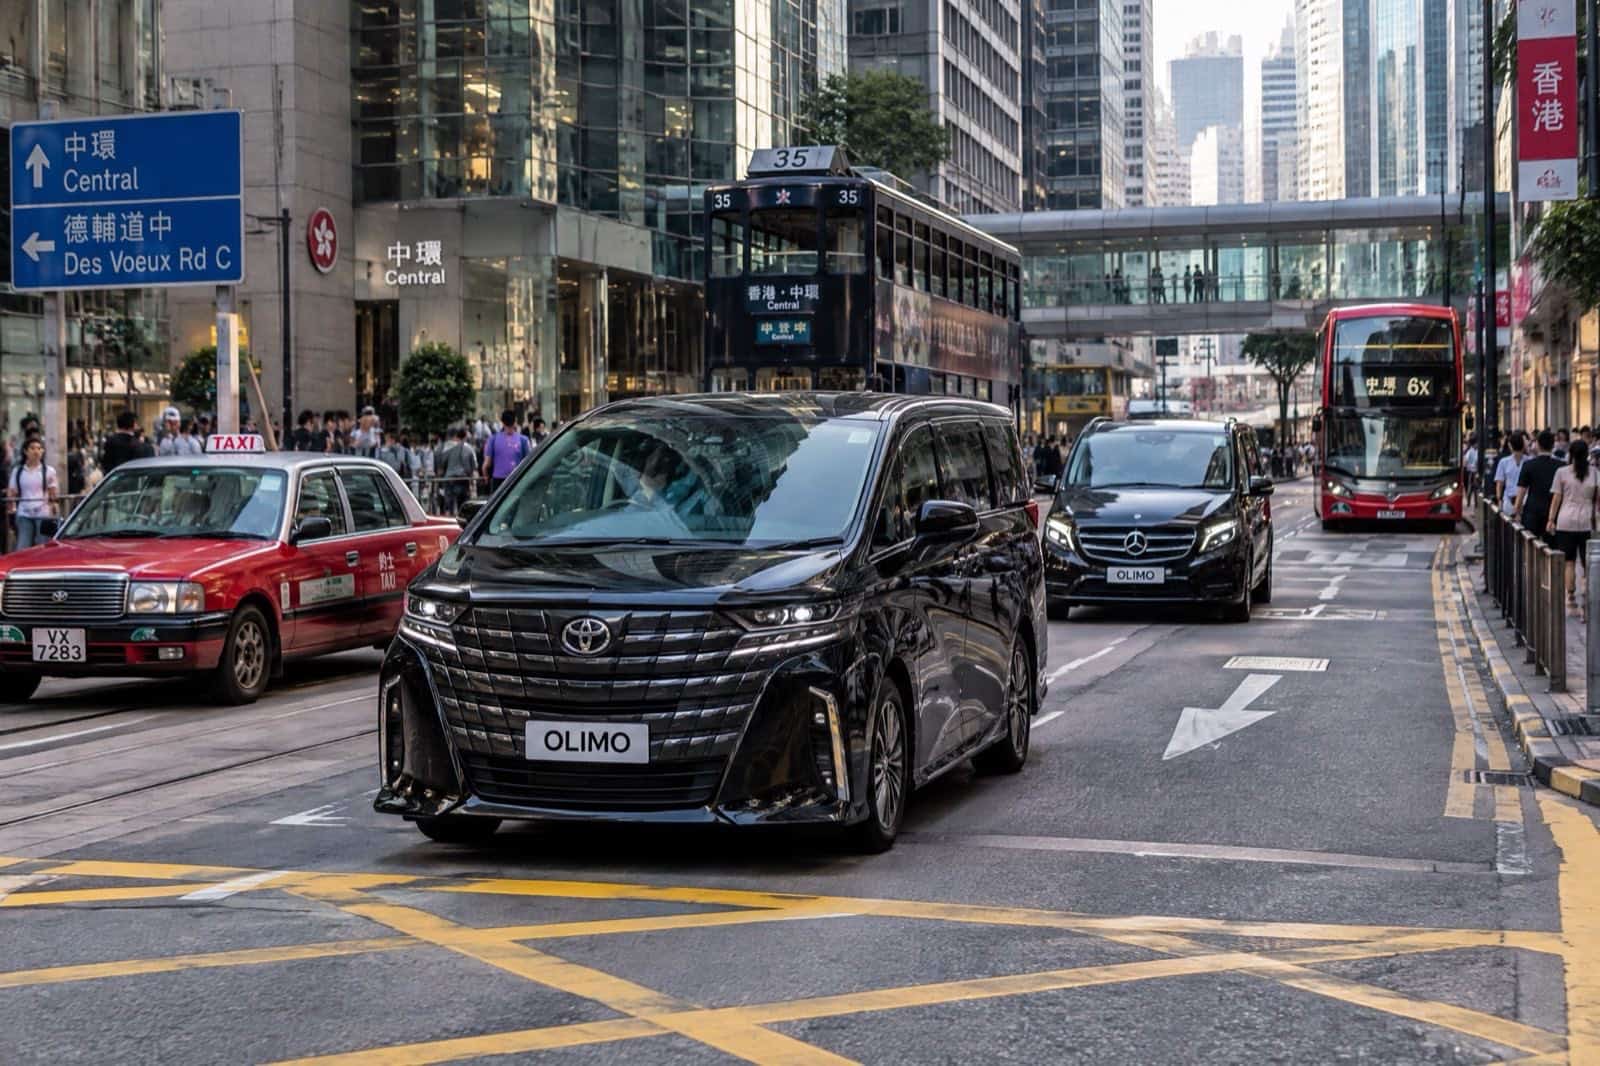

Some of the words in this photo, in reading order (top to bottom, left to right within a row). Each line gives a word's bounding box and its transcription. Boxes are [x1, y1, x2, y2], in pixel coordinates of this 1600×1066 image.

[1532, 60, 1564, 132] 香港
[64, 130, 116, 162] 中環
[774, 149, 809, 168] 35
[63, 167, 139, 193] Central
[715, 193, 731, 208] 35
[839, 190, 858, 204] 35
[64, 210, 172, 244] 德輔道中
[64, 252, 103, 275] Des
[110, 250, 171, 274] Voeux
[180, 247, 206, 271] Rd
[215, 245, 232, 269] C
[388, 240, 442, 267] 中環
[385, 269, 445, 285] Central
[767, 301, 800, 310] Central
[213, 435, 255, 450] TAXI
[380, 571, 396, 591] TAXI
[1117, 570, 1155, 580] OLIMO
[47, 630, 69, 644] VX
[37, 644, 82, 660] 7283
[544, 730, 631, 753] OLIMO
